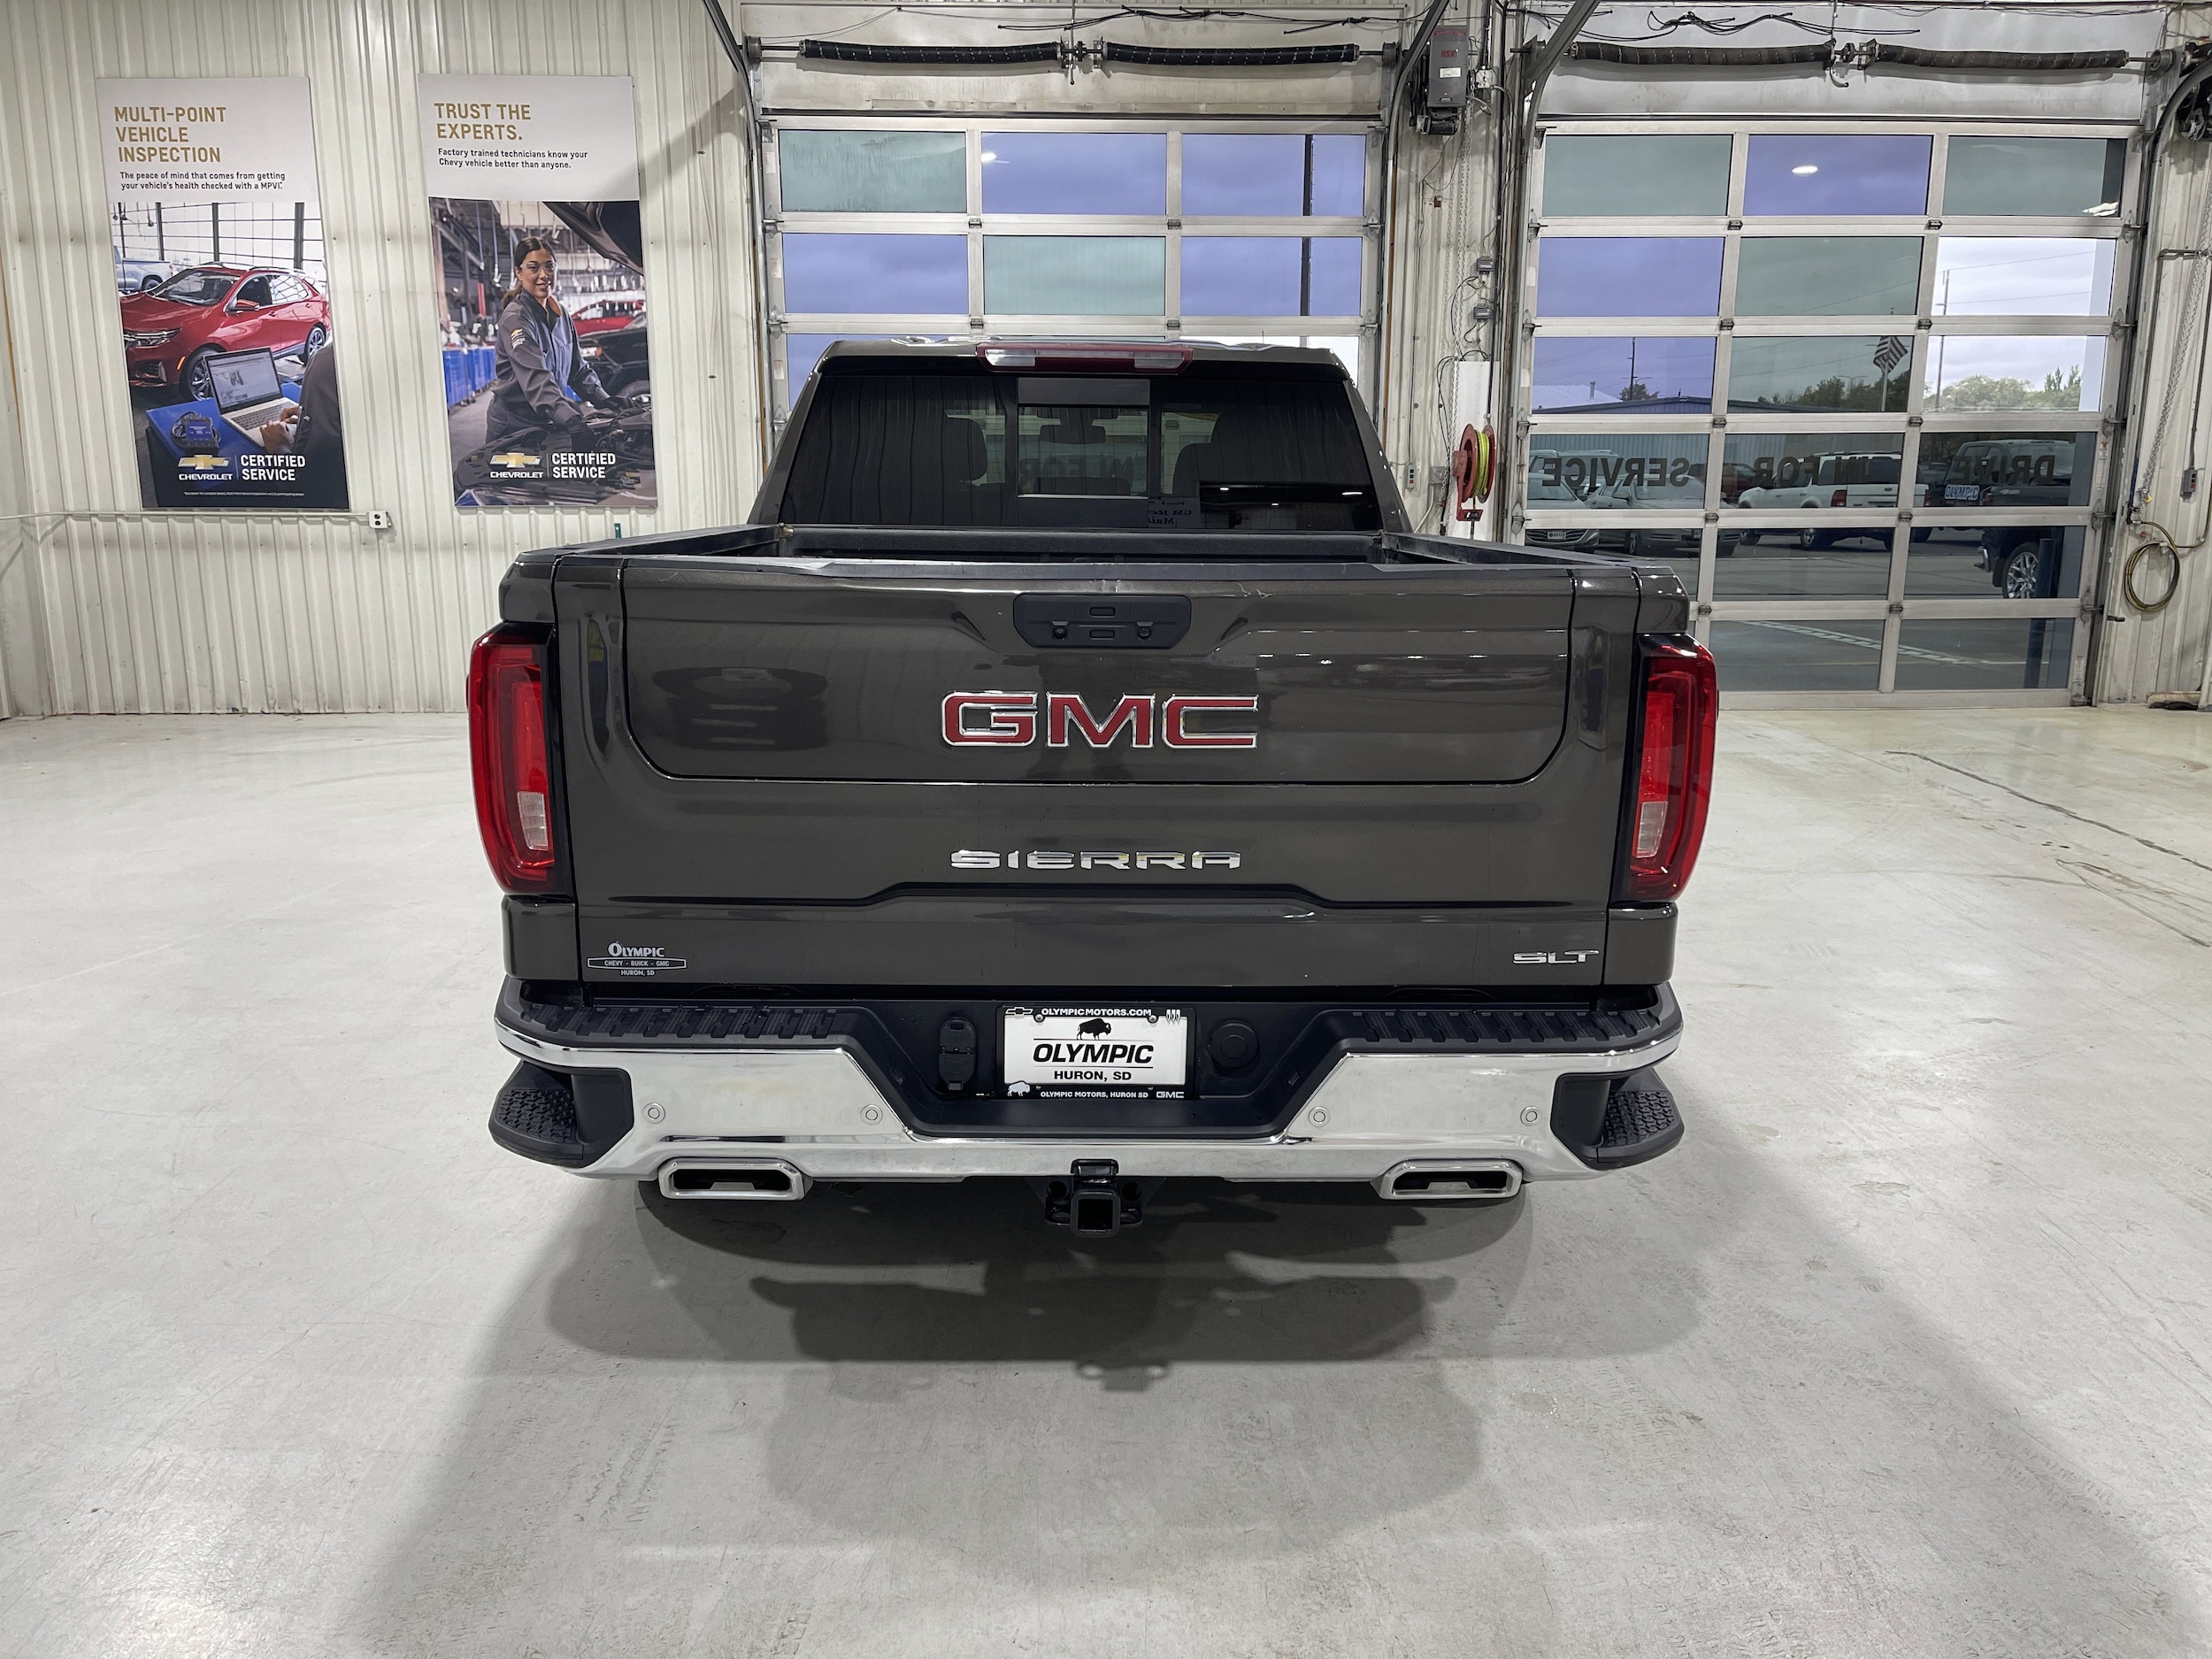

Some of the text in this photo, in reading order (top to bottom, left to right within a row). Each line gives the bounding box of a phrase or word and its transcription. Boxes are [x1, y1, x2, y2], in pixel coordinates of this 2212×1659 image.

[114, 106, 227, 122] MULTI-POINT
[434, 103, 532, 120] TRUST THE
[115, 127, 189, 142] VEHICLE
[436, 123, 523, 141] EXPERTS.
[118, 147, 221, 163] INSPECTION
[438, 148, 469, 158] Factory
[501, 150, 546, 158] technicians
[570, 151, 588, 160] your
[439, 157, 464, 168] Chevy
[495, 159, 519, 168] better
[541, 161, 572, 170] anyone.
[257, 172, 286, 181] getting
[240, 454, 306, 468] CERTIFIED
[551, 452, 616, 465] CERTIFIED
[242, 468, 296, 481] SERVICE
[552, 466, 606, 479] SERVICE
[1946, 485, 1979, 500] OLYMPIC
[941, 690, 1259, 749] GMC
[950, 849, 1240, 870] SIERRA
[1513, 950, 1600, 964] SLT
[1041, 1008, 1152, 1017] OLYMPICMOTORS.COM
[1033, 1043, 1154, 1064] OLYMPIC
[1054, 1071, 1132, 1081] HURON, SD
